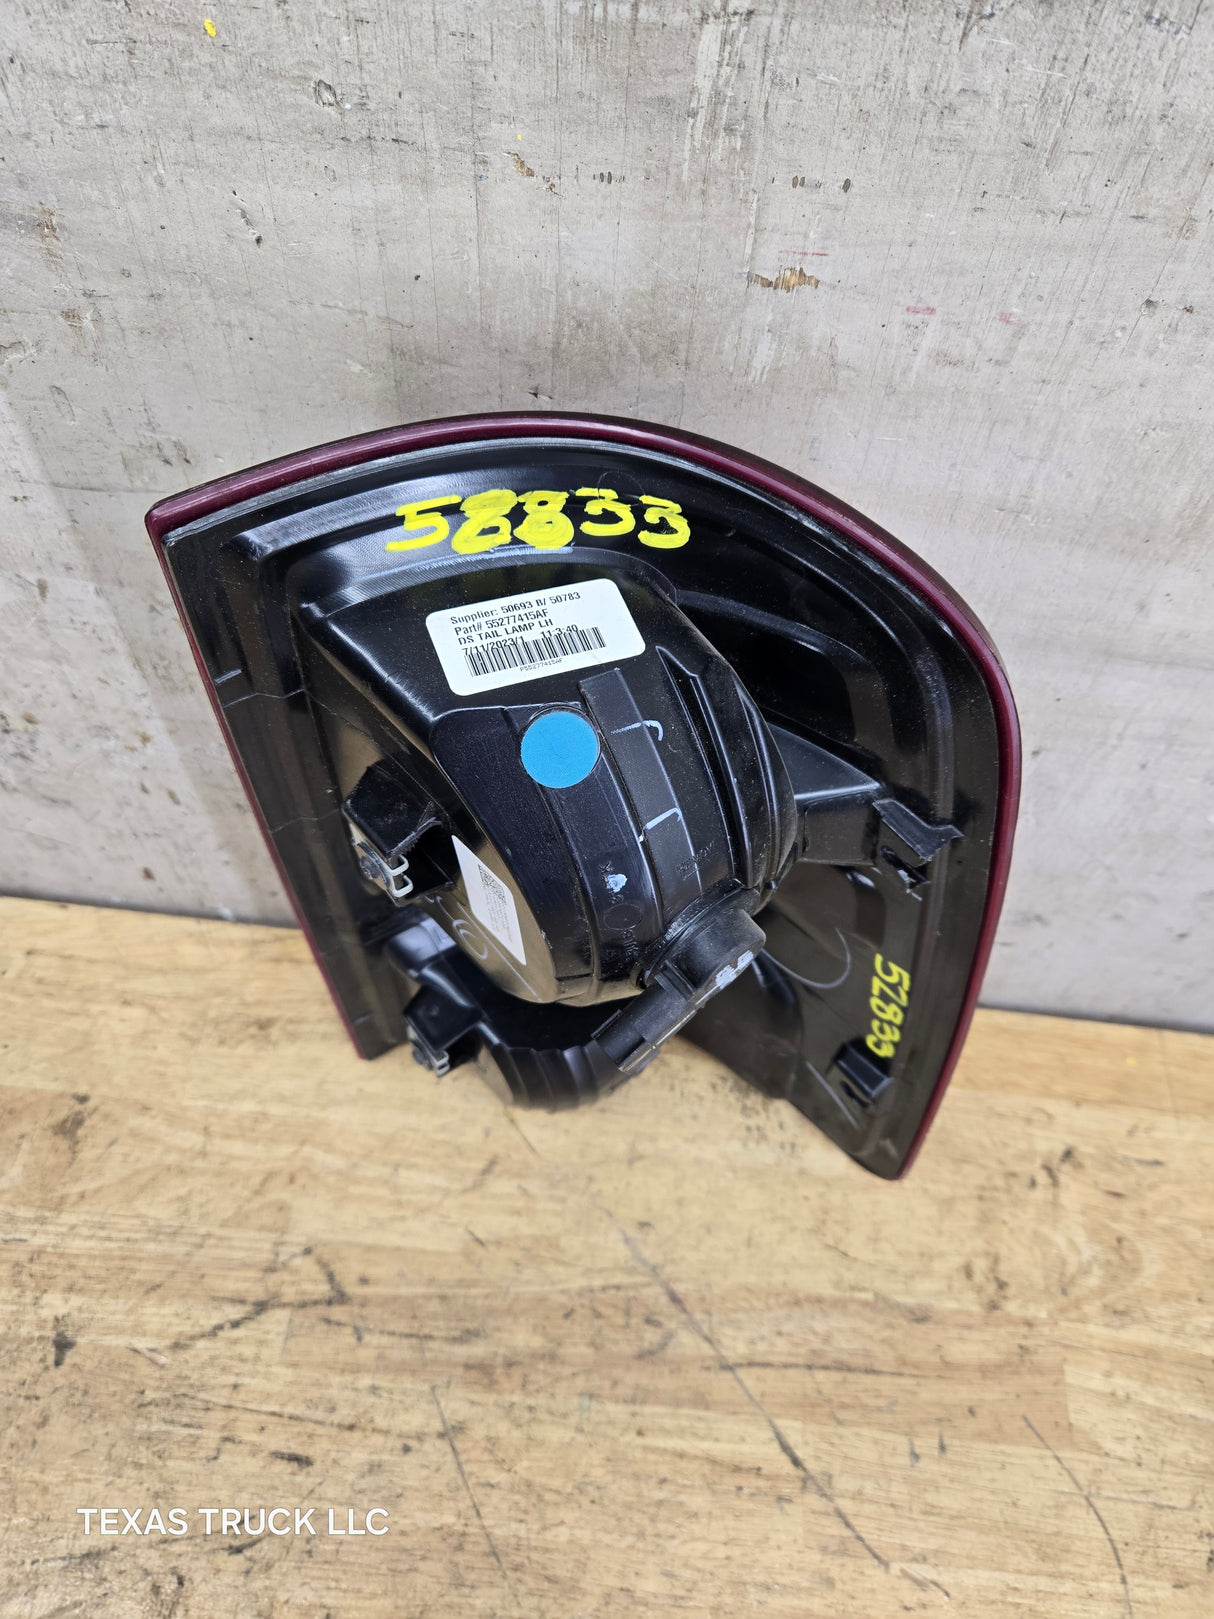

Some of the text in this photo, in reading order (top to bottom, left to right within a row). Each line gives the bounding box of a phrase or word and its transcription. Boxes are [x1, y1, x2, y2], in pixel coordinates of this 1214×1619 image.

[450, 591, 581, 625] Supplier: 50693 B/ 50783
[454, 608, 549, 636] Part# 55277415AF
[458, 619, 553, 646] DS TAIL LAMP LH
